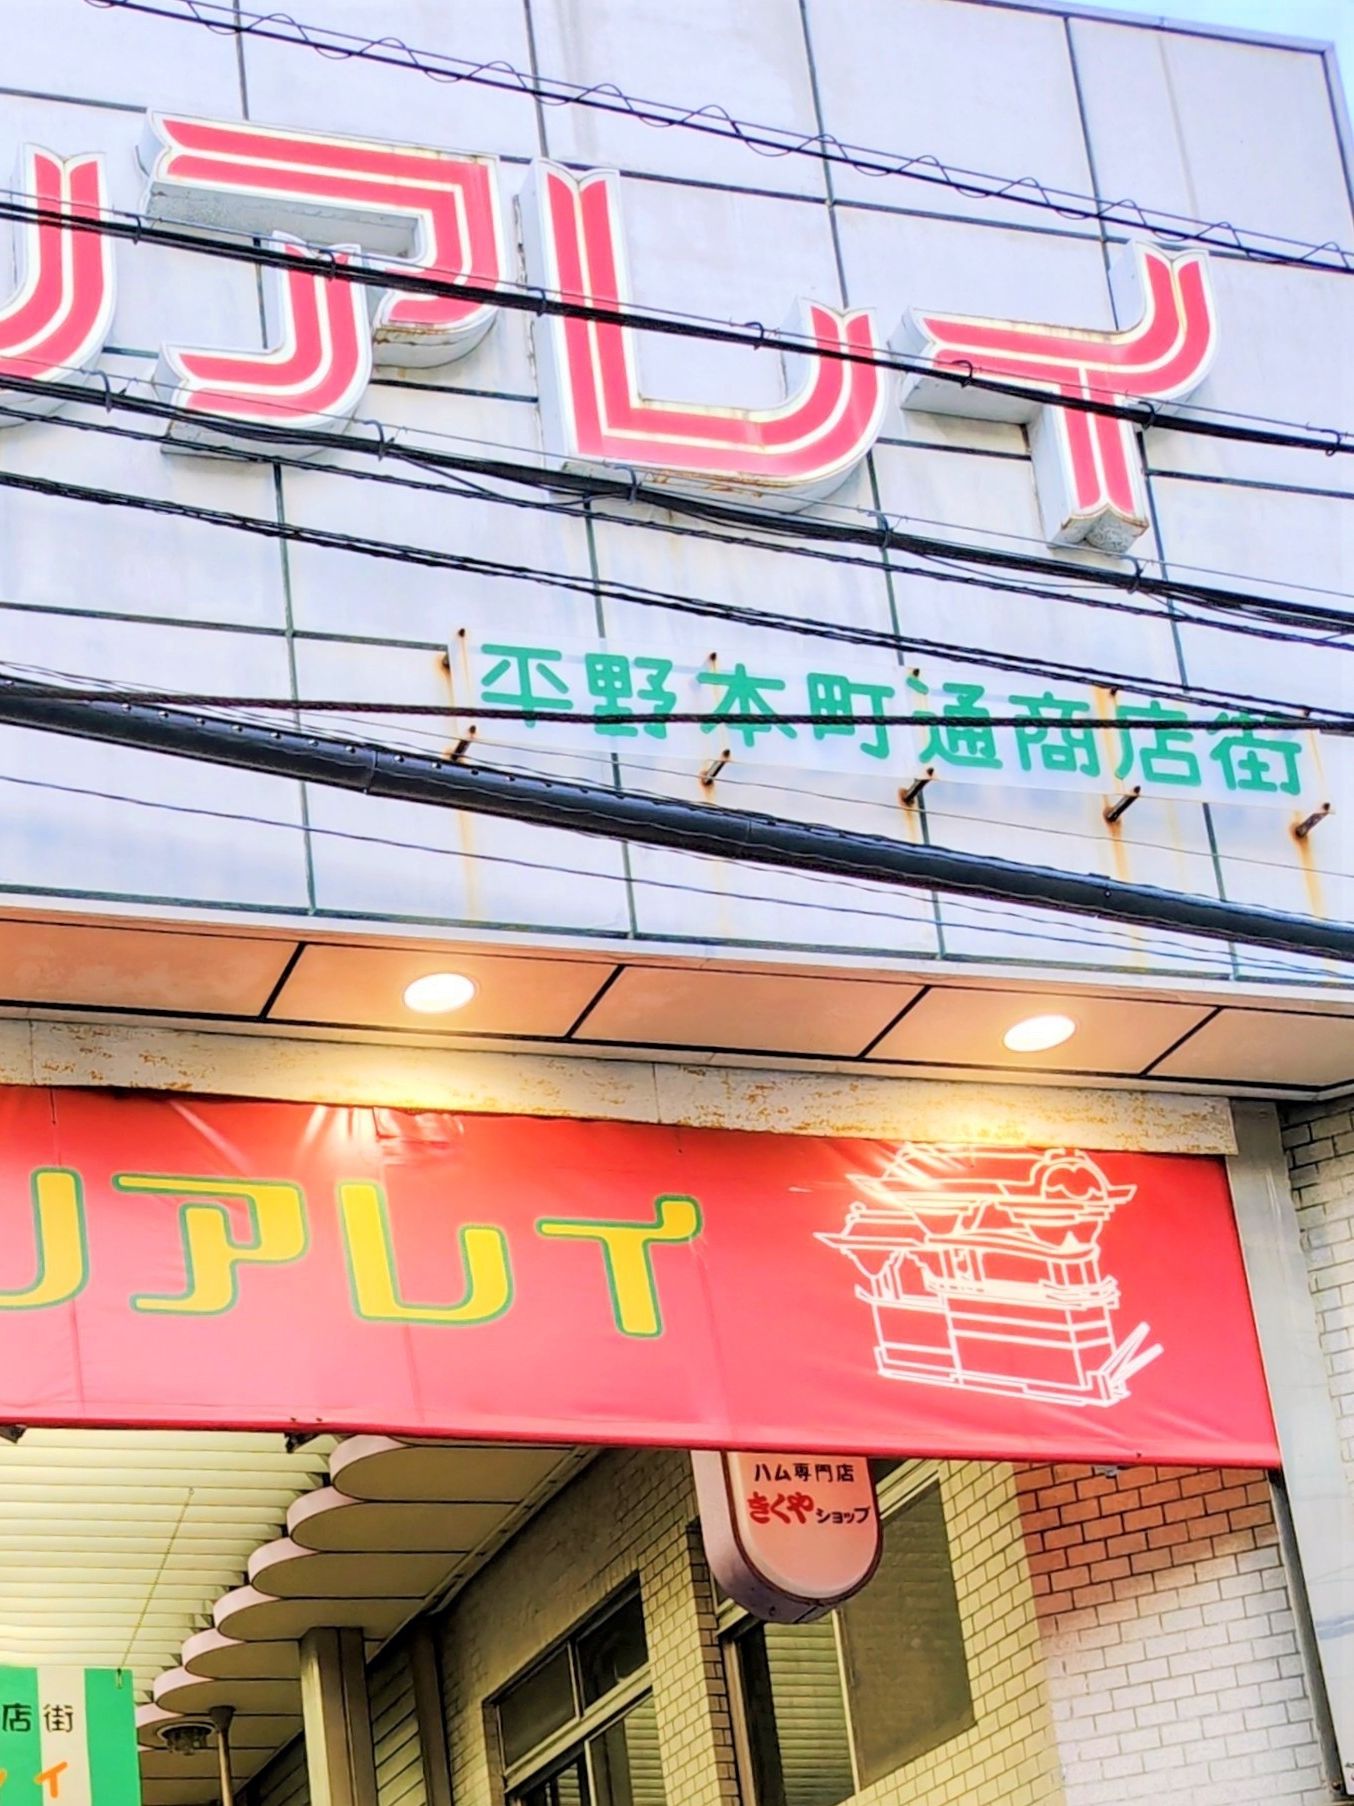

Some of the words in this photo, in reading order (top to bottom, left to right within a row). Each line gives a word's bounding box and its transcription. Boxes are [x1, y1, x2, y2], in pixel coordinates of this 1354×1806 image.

[481, 642, 1304, 797] 平野本町通商店街
[753, 1462, 855, 1483] ハム専門店
